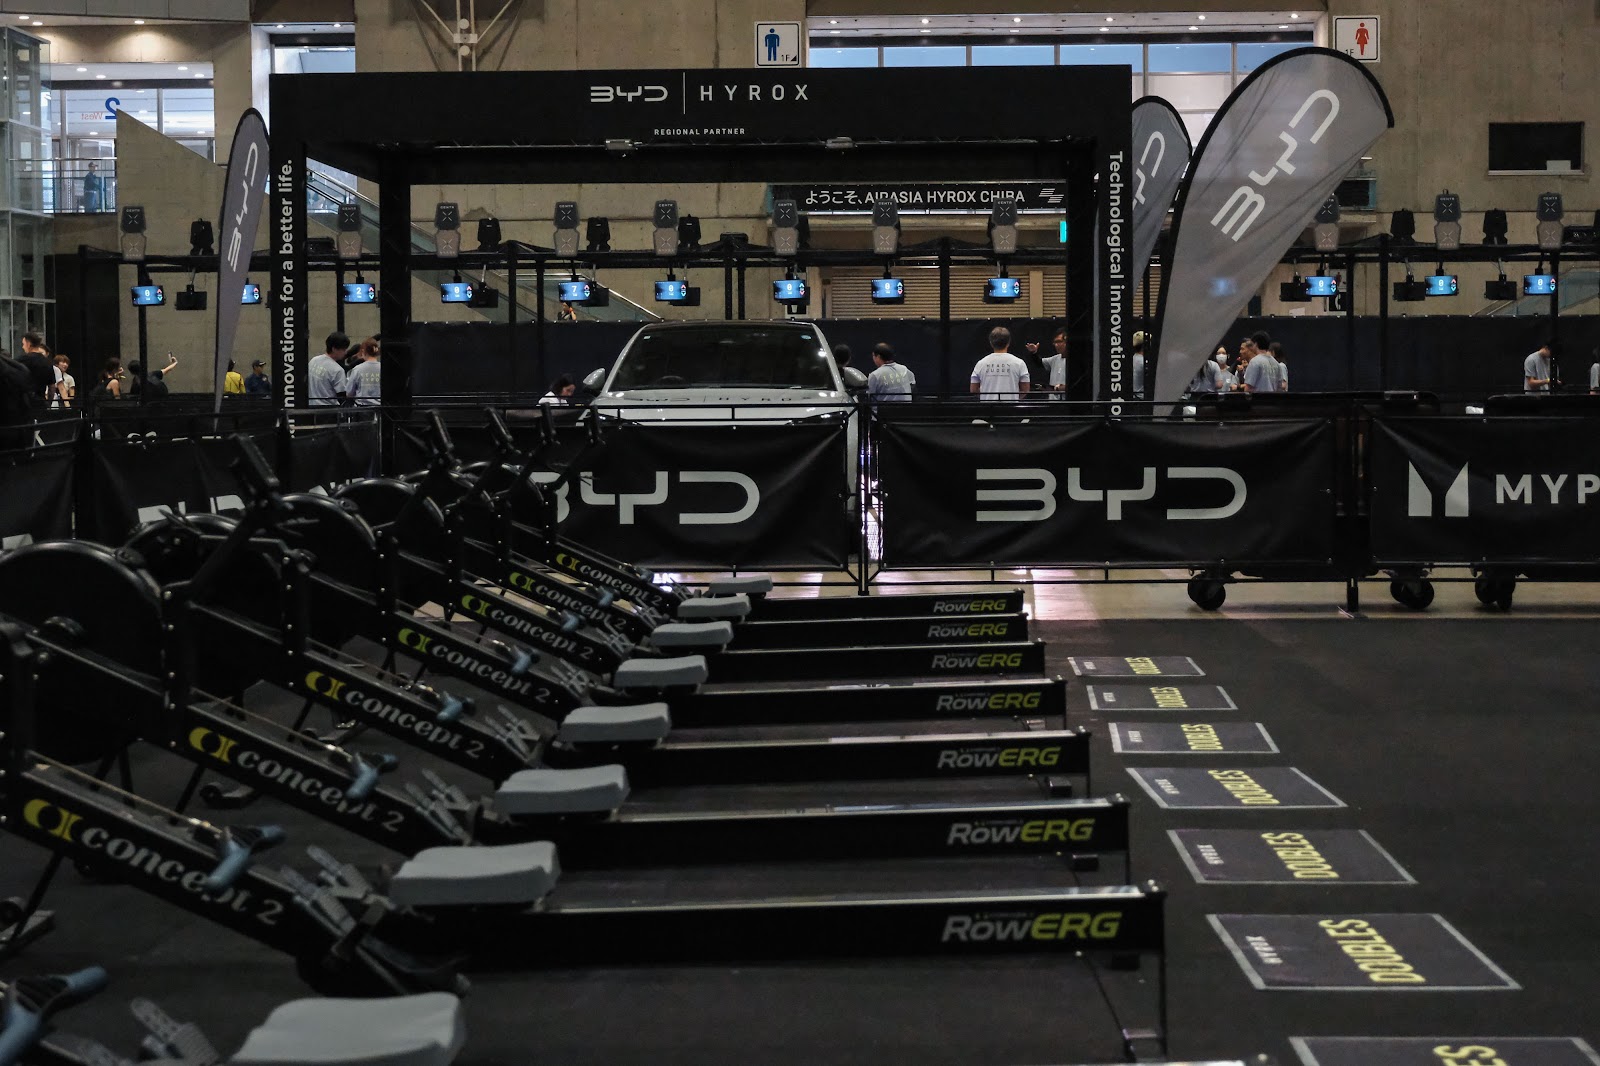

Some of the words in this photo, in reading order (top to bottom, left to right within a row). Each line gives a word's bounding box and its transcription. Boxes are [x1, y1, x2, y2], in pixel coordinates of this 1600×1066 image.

[590, 86, 668, 102] BYD
[700, 84, 809, 101] HYROX
[654, 128, 700, 136] REGIONAL
[278, 160, 293, 192] life.
[1133, 131, 1166, 210] YD
[1210, 89, 1340, 242] BYD
[228, 142, 258, 272] BYD
[805, 190, 863, 204] ようこそ、
[927, 190, 977, 203] HYROX
[1107, 151, 1124, 279] Technological
[279, 198, 293, 254] better
[280, 276, 294, 302] for
[282, 260, 293, 271] a
[280, 307, 294, 408] nnovations
[1110, 285, 1125, 392] innovations
[1110, 396, 1125, 422] fo
[976, 467, 1247, 521] BYD
[1495, 474, 1600, 504] MYP
[1261, 832, 1340, 879] DOUBLES
[1318, 919, 1426, 983] DOUBLES
